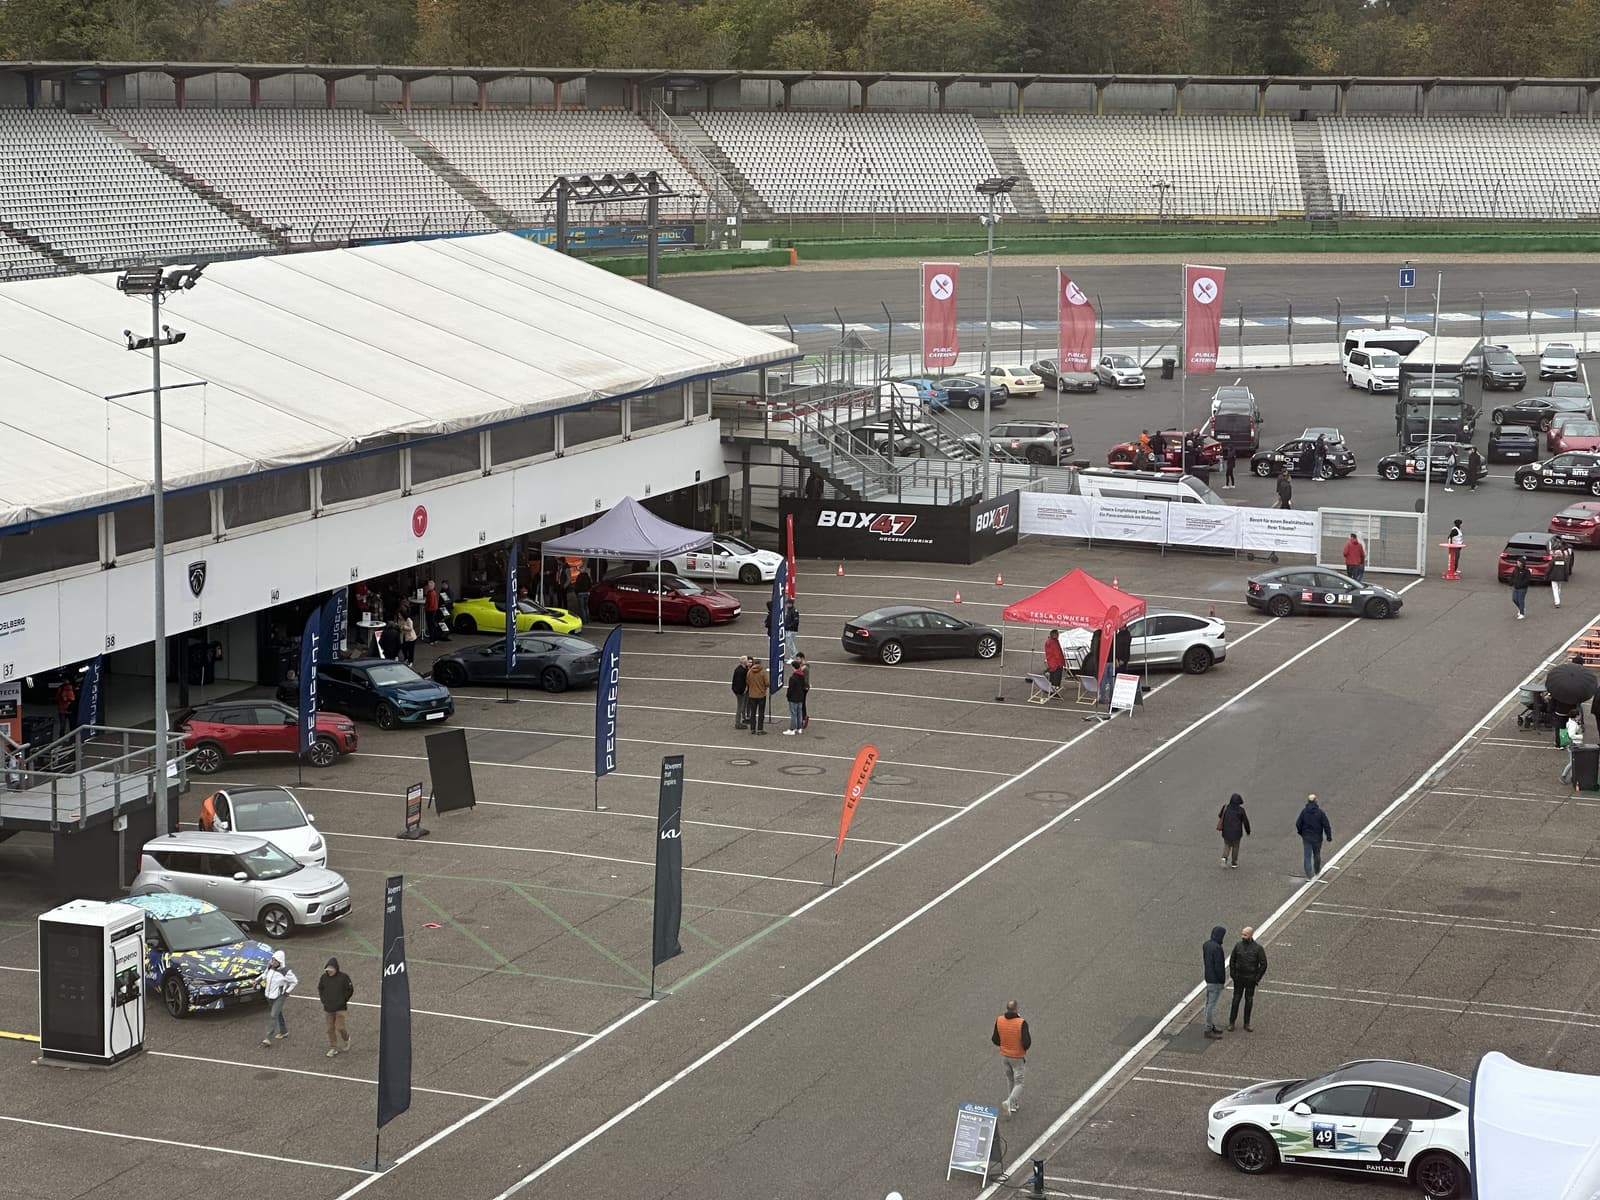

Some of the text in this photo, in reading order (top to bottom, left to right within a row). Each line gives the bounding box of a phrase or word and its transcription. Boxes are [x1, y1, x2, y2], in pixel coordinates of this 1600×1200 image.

[1030, 611, 1053, 620] TESLA
[1056, 614, 1090, 623] OWNERS
[106, 635, 116, 648] 38
[4, 663, 14, 676] 37
[606, 652, 619, 770] PEUGEOT
[1315, 1130, 1333, 1143] 49
[1366, 1164, 1404, 1174] PANTABX
